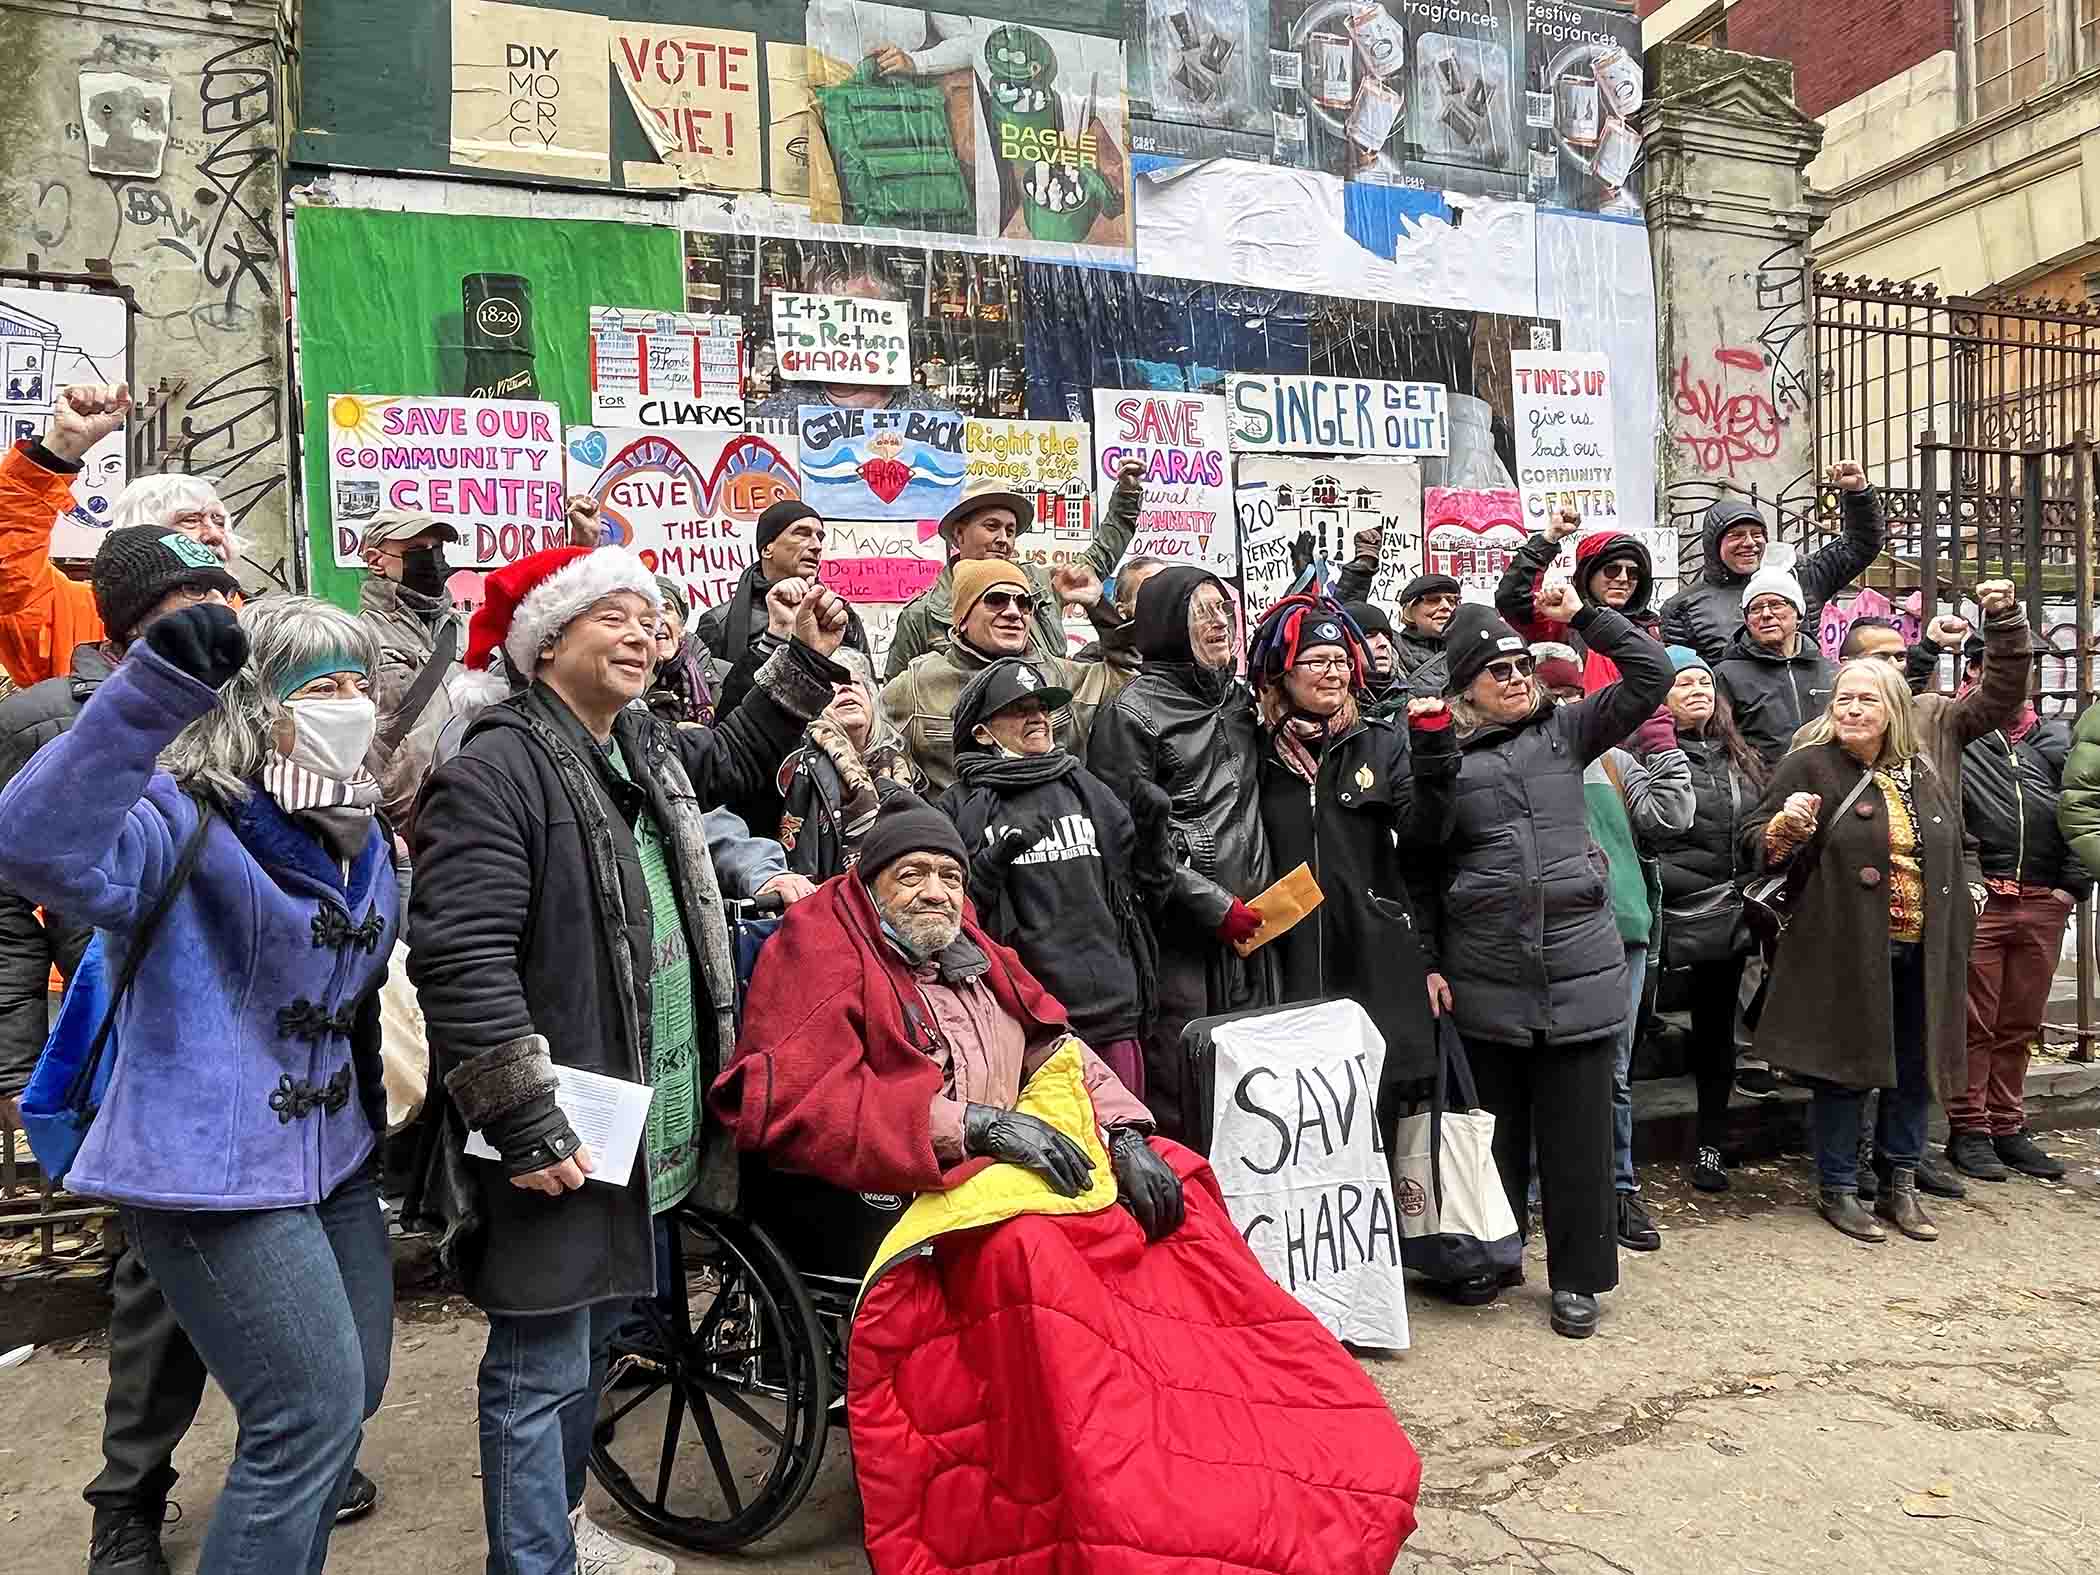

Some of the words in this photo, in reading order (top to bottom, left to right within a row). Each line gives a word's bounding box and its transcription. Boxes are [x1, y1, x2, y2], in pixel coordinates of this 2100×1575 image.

[1403, 0, 1499, 28] Fragrances
[1527, 0, 1582, 25] Festive
[1527, 17, 1618, 48] Fragrances
[506, 43, 559, 71] DIY
[619, 37, 750, 92] VOTE
[509, 71, 560, 99] MO
[509, 98, 557, 127] CR
[509, 126, 558, 151] CY
[1001, 141, 1097, 169] DOVER
[481, 306, 519, 328] 1829
[778, 297, 830, 320] It's
[834, 299, 893, 325] Time
[777, 322, 816, 347] to
[1583, 370, 1606, 397] UP
[598, 395, 625, 406] FOR
[1384, 383, 1441, 414] GET
[383, 407, 468, 436] SAVE
[476, 409, 554, 443] OUR
[639, 401, 745, 427] CHARAS
[1115, 397, 1205, 448] SAVE
[1528, 406, 1567, 438] give
[1570, 412, 1595, 426] us
[802, 409, 865, 450] GIVE
[873, 410, 901, 429] IT
[904, 412, 965, 454] BACK
[967, 420, 1034, 461] Right
[1039, 423, 1080, 456] the
[1385, 411, 1447, 450] OUT!
[336, 446, 549, 471] COMMUNITY
[1530, 437, 1570, 457] back
[1521, 466, 1613, 484] COMMUNITY
[389, 478, 565, 521] CENTER
[610, 481, 687, 509] GIVE
[662, 518, 741, 541] THEIR
[1241, 499, 1274, 533] 20
[1381, 515, 1399, 530] IN
[475, 523, 566, 563] DORM
[829, 528, 925, 560] MAYOR
[1025, 549, 1048, 565] US
[1242, 535, 1287, 564] YEARS
[1381, 548, 1400, 560] OF
[1246, 558, 1289, 581] EMPTY
